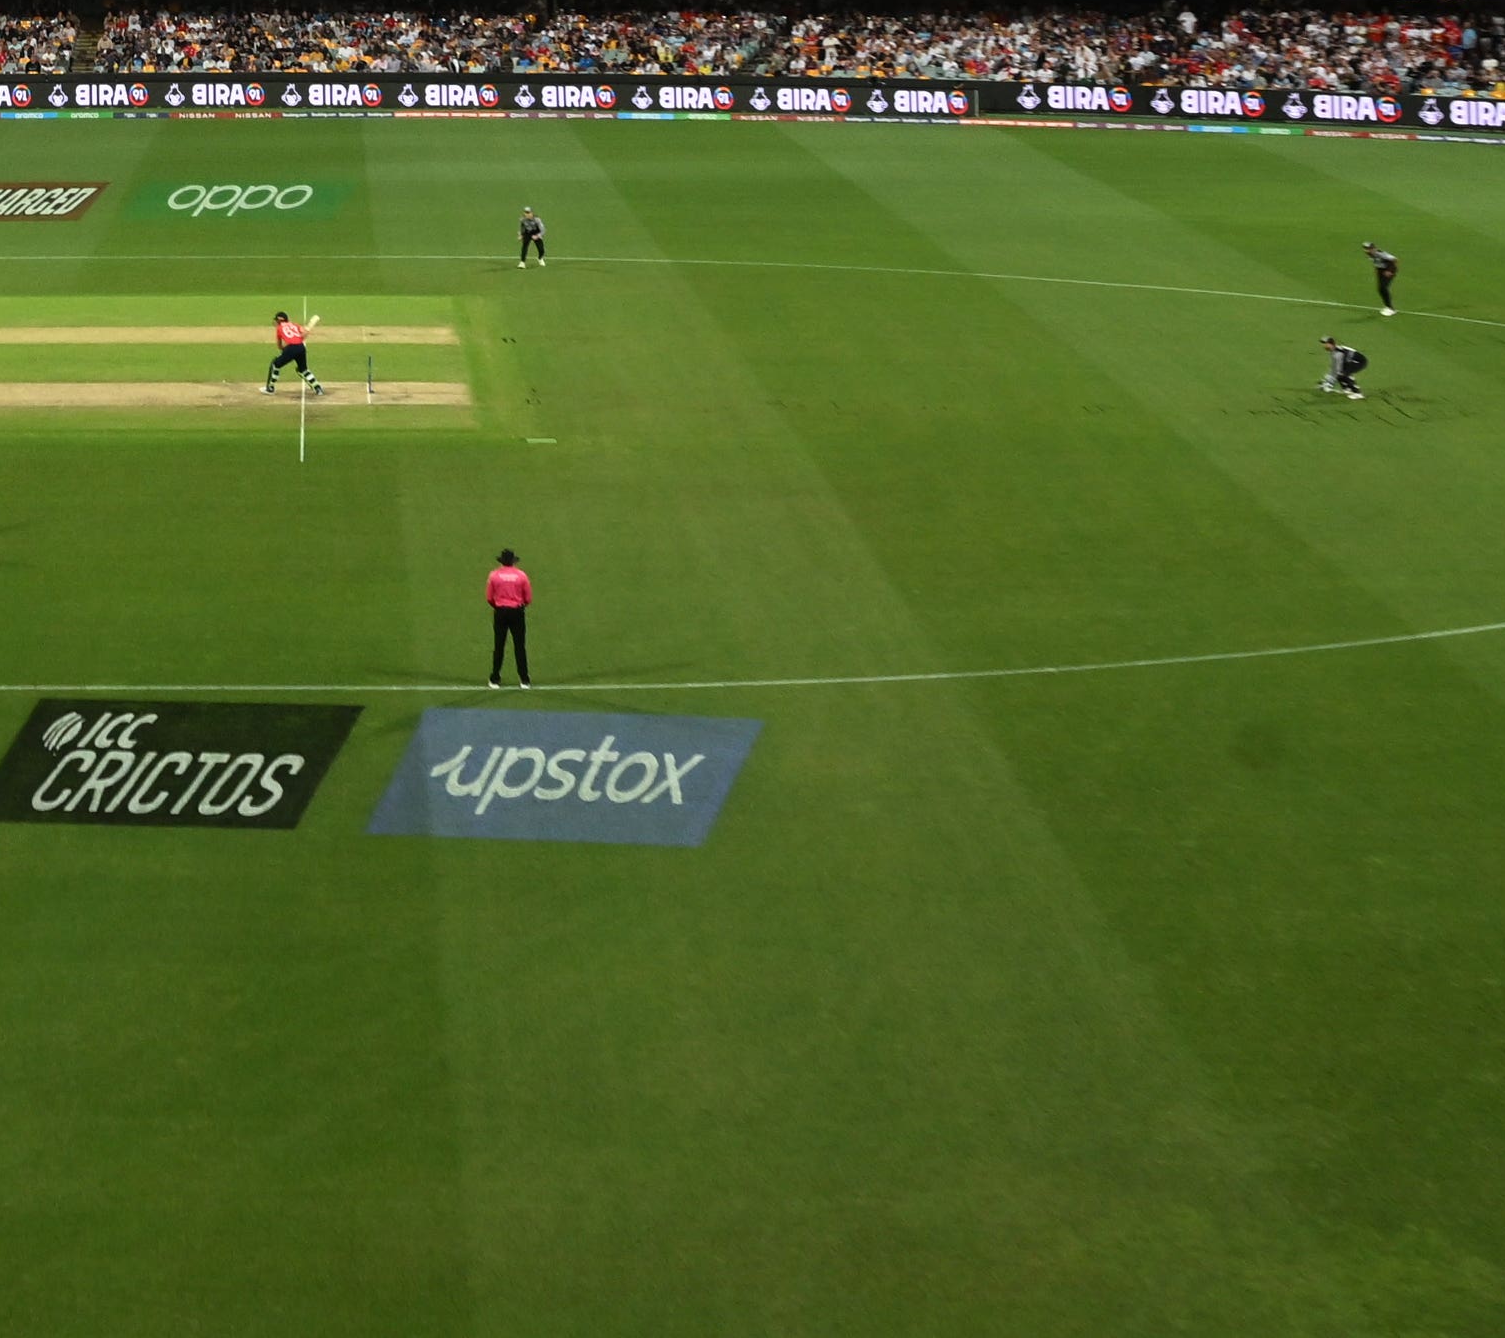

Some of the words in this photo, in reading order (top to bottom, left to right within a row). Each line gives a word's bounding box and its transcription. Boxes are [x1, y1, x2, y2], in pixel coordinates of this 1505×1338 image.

[75, 84, 130, 106] BIRA
[308, 84, 364, 106] BIRA
[541, 85, 597, 108] BIRA
[777, 88, 833, 111] BIRA
[1047, 85, 1110, 111] BIRA
[167, 184, 314, 217] oppo
[76, 712, 158, 750] ICC
[31, 750, 305, 817] CRICTOS
[430, 734, 706, 815] upstox
